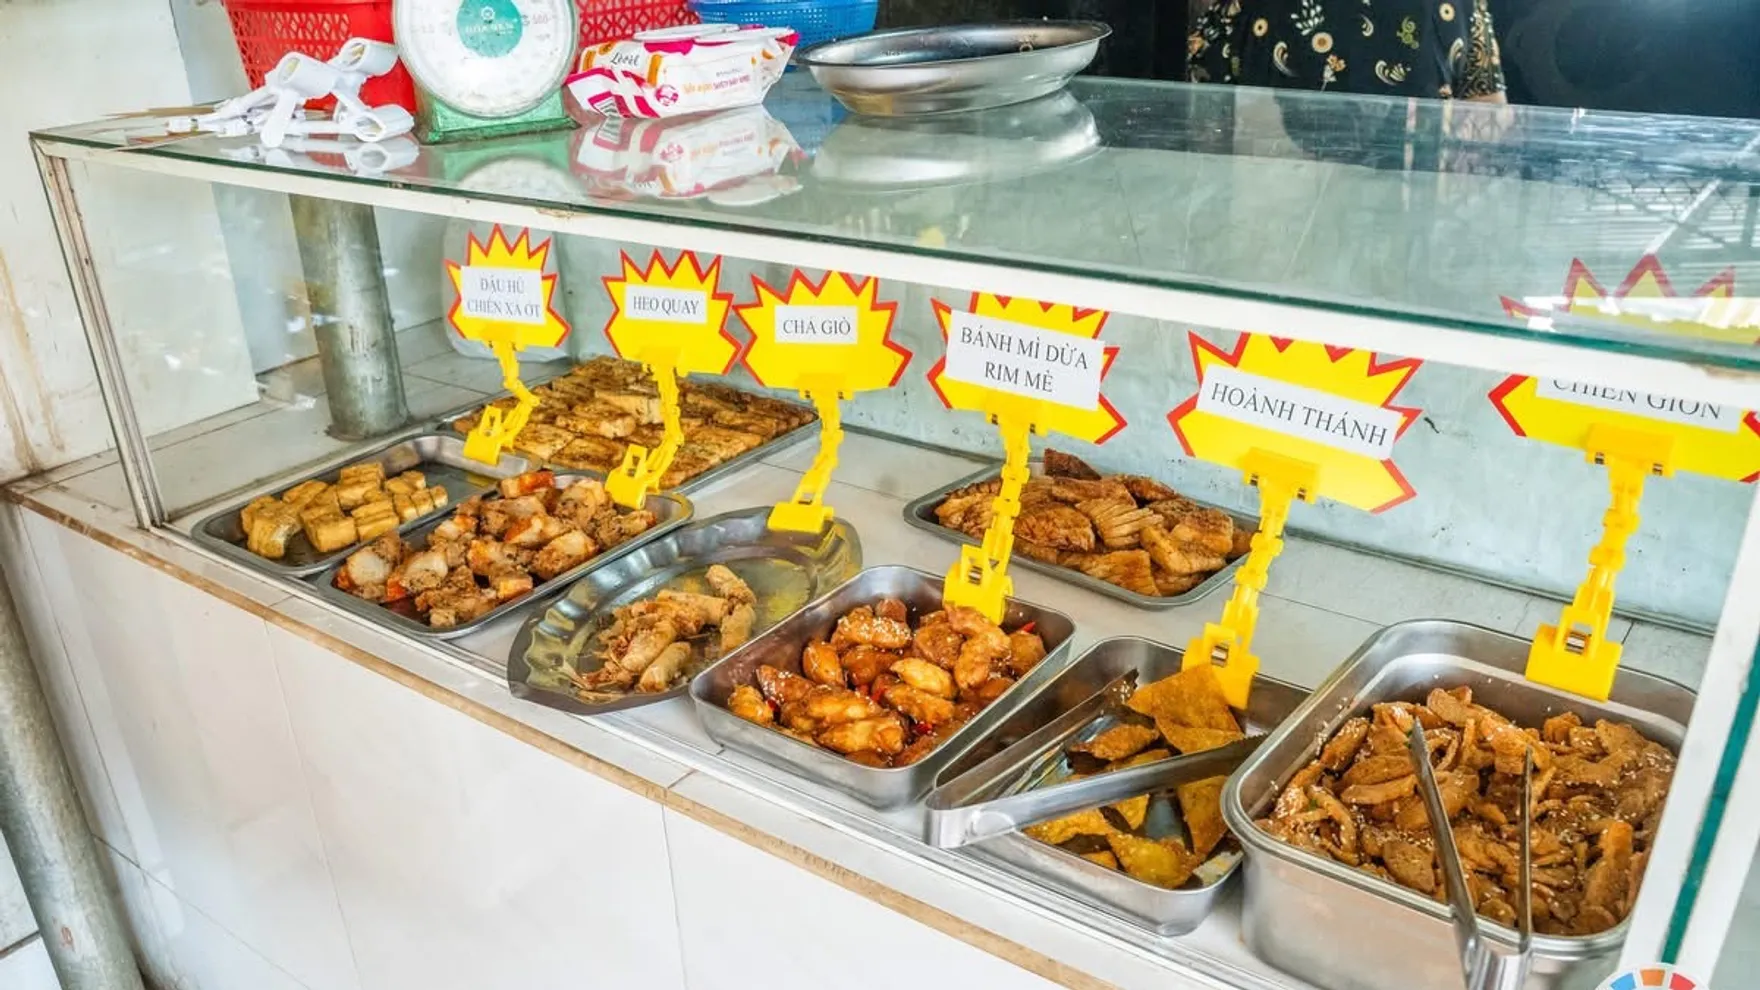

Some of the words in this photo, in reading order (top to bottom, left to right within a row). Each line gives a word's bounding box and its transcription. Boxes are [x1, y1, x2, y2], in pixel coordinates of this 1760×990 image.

[633, 295, 659, 312] HEO
[661, 297, 700, 316] QUAY
[821, 316, 851, 335] GIÒ
[961, 325, 1012, 353] BÁNH
[1017, 336, 1041, 359] MÌ
[1046, 342, 1088, 370] DỪA
[985, 361, 1019, 385] RIM
[1024, 370, 1054, 393] MÈ
[1211, 382, 1295, 421] HOÀNH
[1302, 405, 1389, 447] THÁNH
